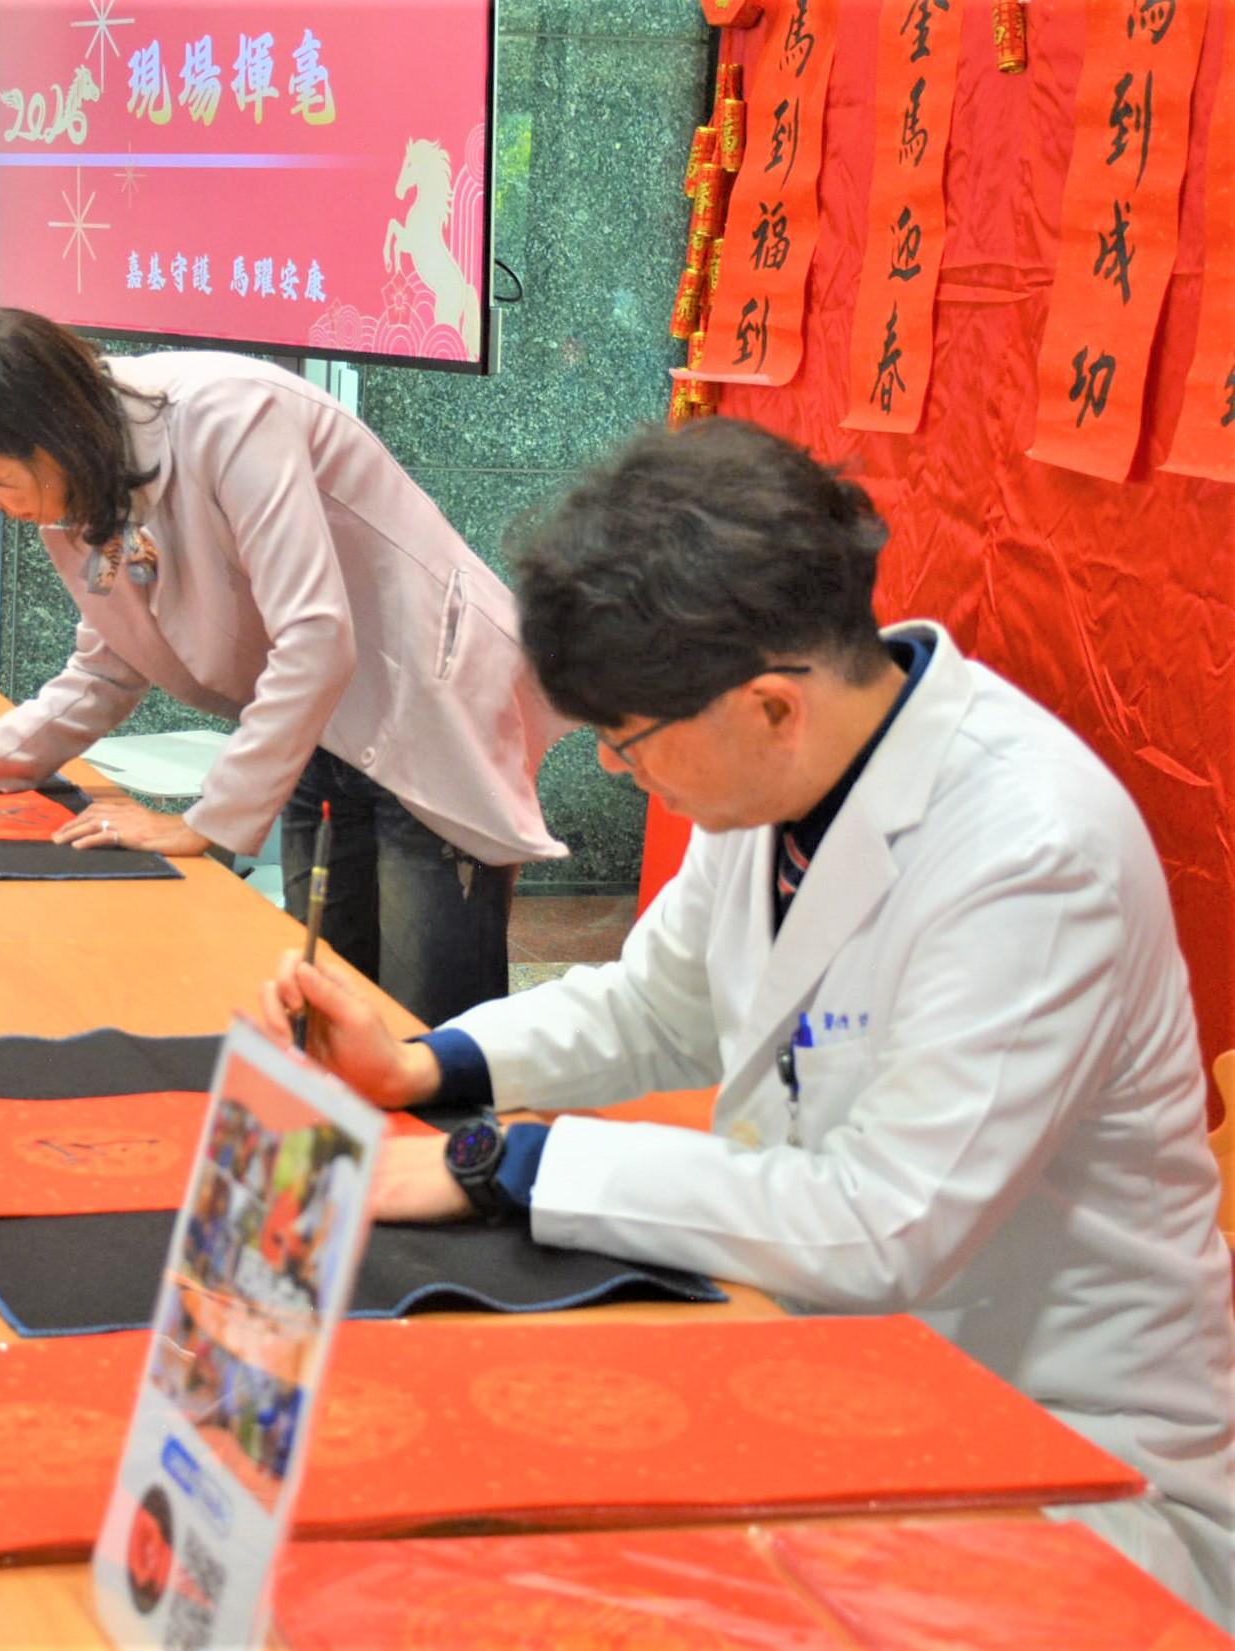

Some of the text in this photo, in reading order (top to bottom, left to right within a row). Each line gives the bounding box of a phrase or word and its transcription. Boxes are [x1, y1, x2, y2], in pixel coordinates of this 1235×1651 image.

[126, 28, 336, 127] 現場揮毫
[126, 250, 327, 303] 嘉基守護 馬躍安康
